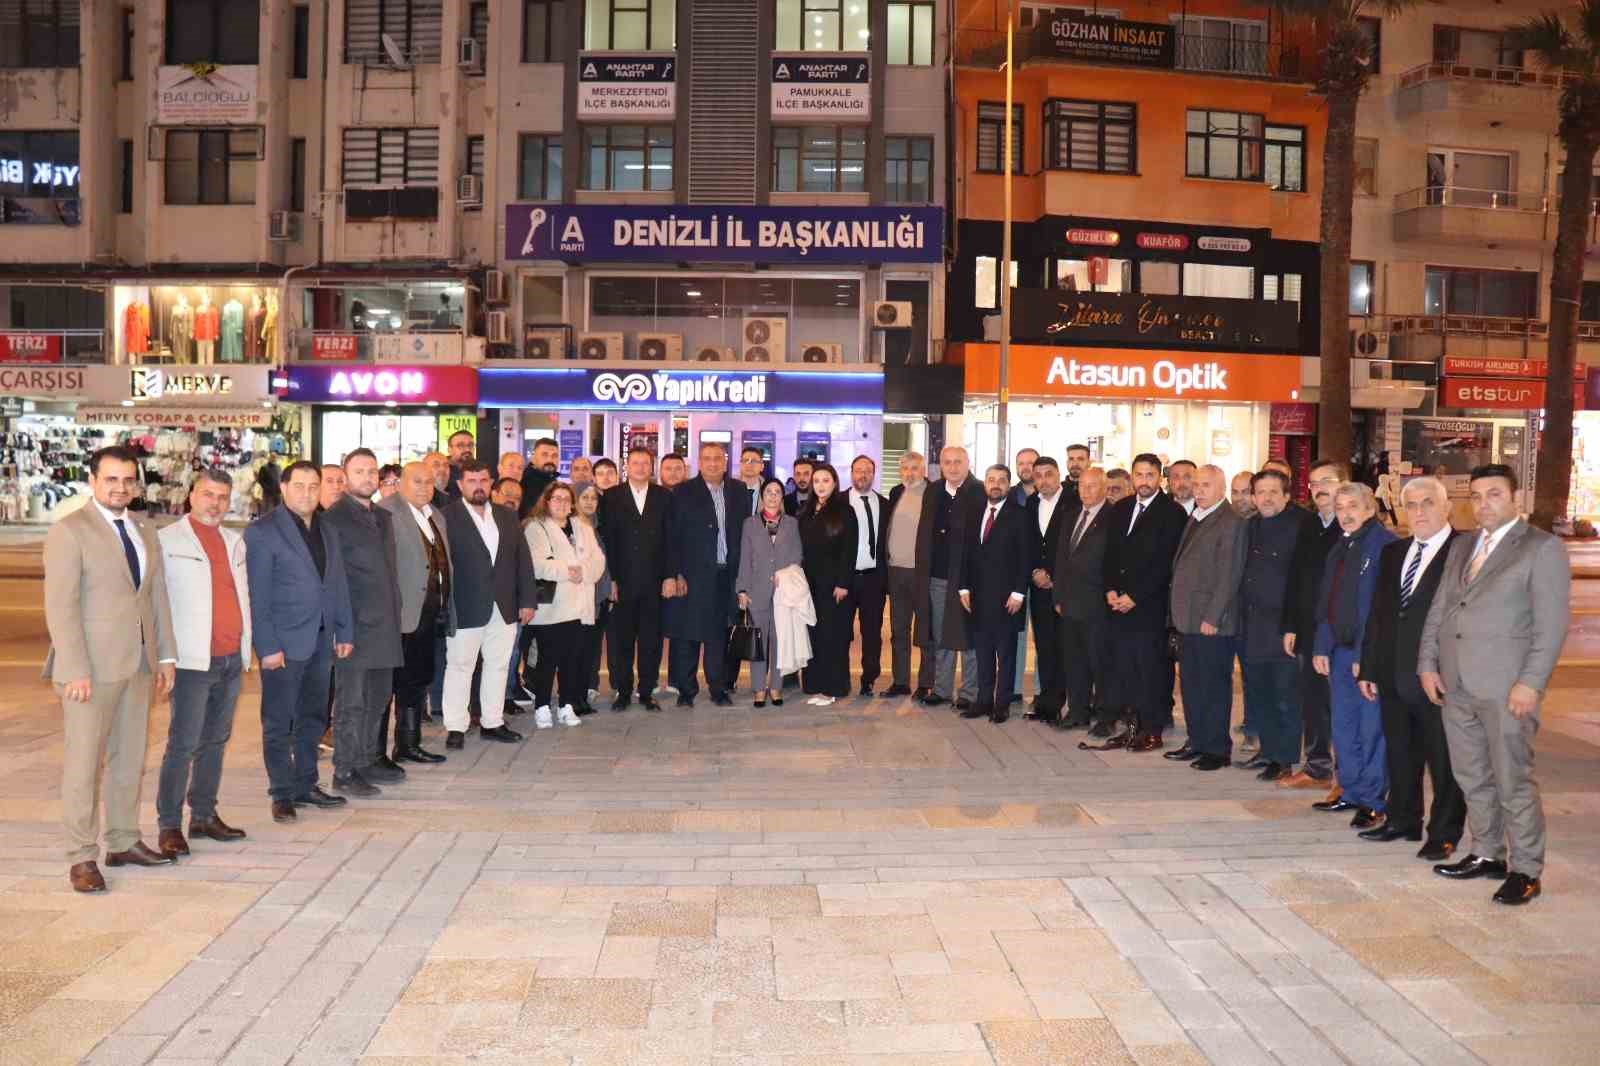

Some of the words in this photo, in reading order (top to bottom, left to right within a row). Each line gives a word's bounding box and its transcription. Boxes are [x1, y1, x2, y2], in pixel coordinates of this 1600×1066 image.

[1051, 18, 1109, 41] GÖZHAN
[799, 64, 848, 72] ANAHTAR
[790, 88, 852, 97] PAMUKKALE
[560, 215, 585, 242] A
[613, 214, 719, 247] DENİZLİ
[726, 215, 752, 247] İL
[758, 214, 924, 255] BAŞKANLIĞI
[1143, 235, 1181, 248] KUAFÖR
[163, 374, 234, 393] MERVE
[329, 372, 425, 394] AVON
[1046, 356, 1146, 387] Atasun
[1153, 360, 1228, 395] Optik
[1458, 385, 1531, 402] etstur
[86, 413, 128, 423] MERVE
[135, 413, 184, 425] ÇORAP
[199, 414, 260, 426] ÇAMAŞIR
